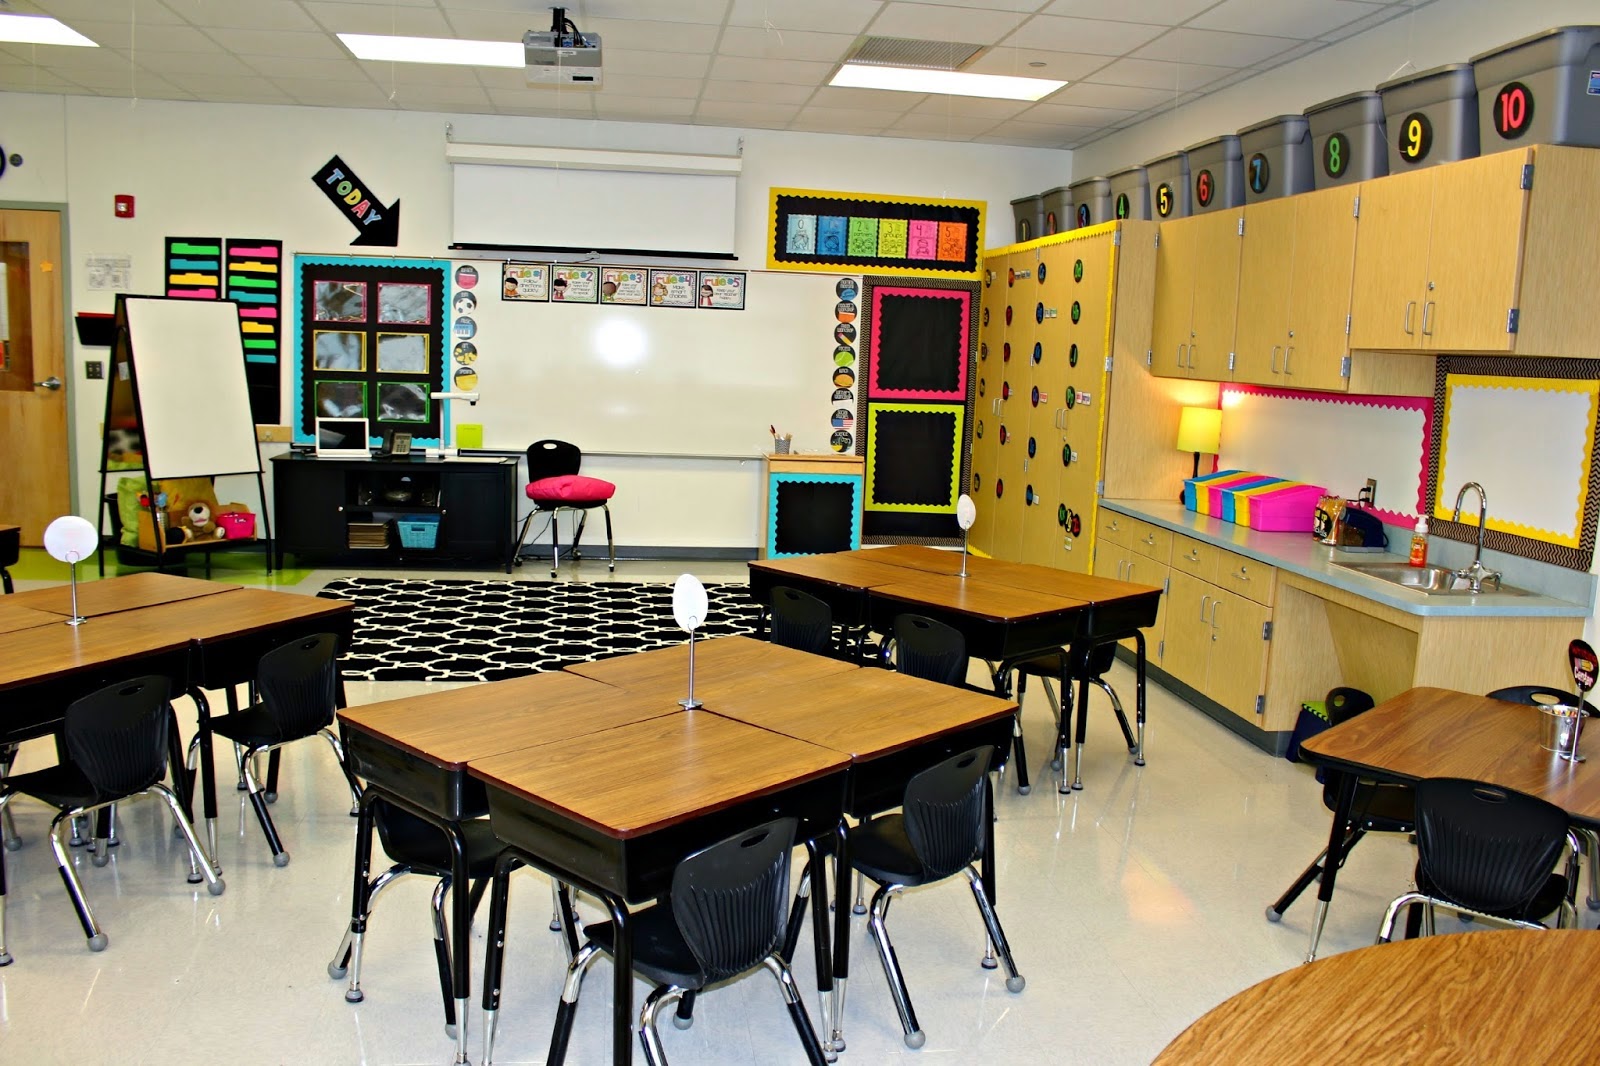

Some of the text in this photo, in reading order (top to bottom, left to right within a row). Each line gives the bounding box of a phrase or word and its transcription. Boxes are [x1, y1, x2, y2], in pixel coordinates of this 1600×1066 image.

[1501, 88, 1525, 132] 10
[1407, 119, 1421, 157] 9
[1329, 137, 1341, 173] 8
[1252, 158, 1262, 191] 7
[1200, 173, 1208, 201] 6
[326, 167, 382, 226] TODAY
[1160, 187, 1168, 215] 5
[1118, 196, 1125, 219] 4
[1080, 206, 1087, 228] 3
[798, 219, 804, 230] 0
[857, 221, 862, 232] 2
[887, 222, 893, 234] 3
[916, 225, 922, 236] 4
[945, 227, 951, 238] 5
[509, 267, 532, 279] rule
[557, 268, 594, 282] rule #2
[606, 270, 643, 284] rule #3
[655, 273, 692, 287] rule #4
[704, 275, 740, 288] rule #5
